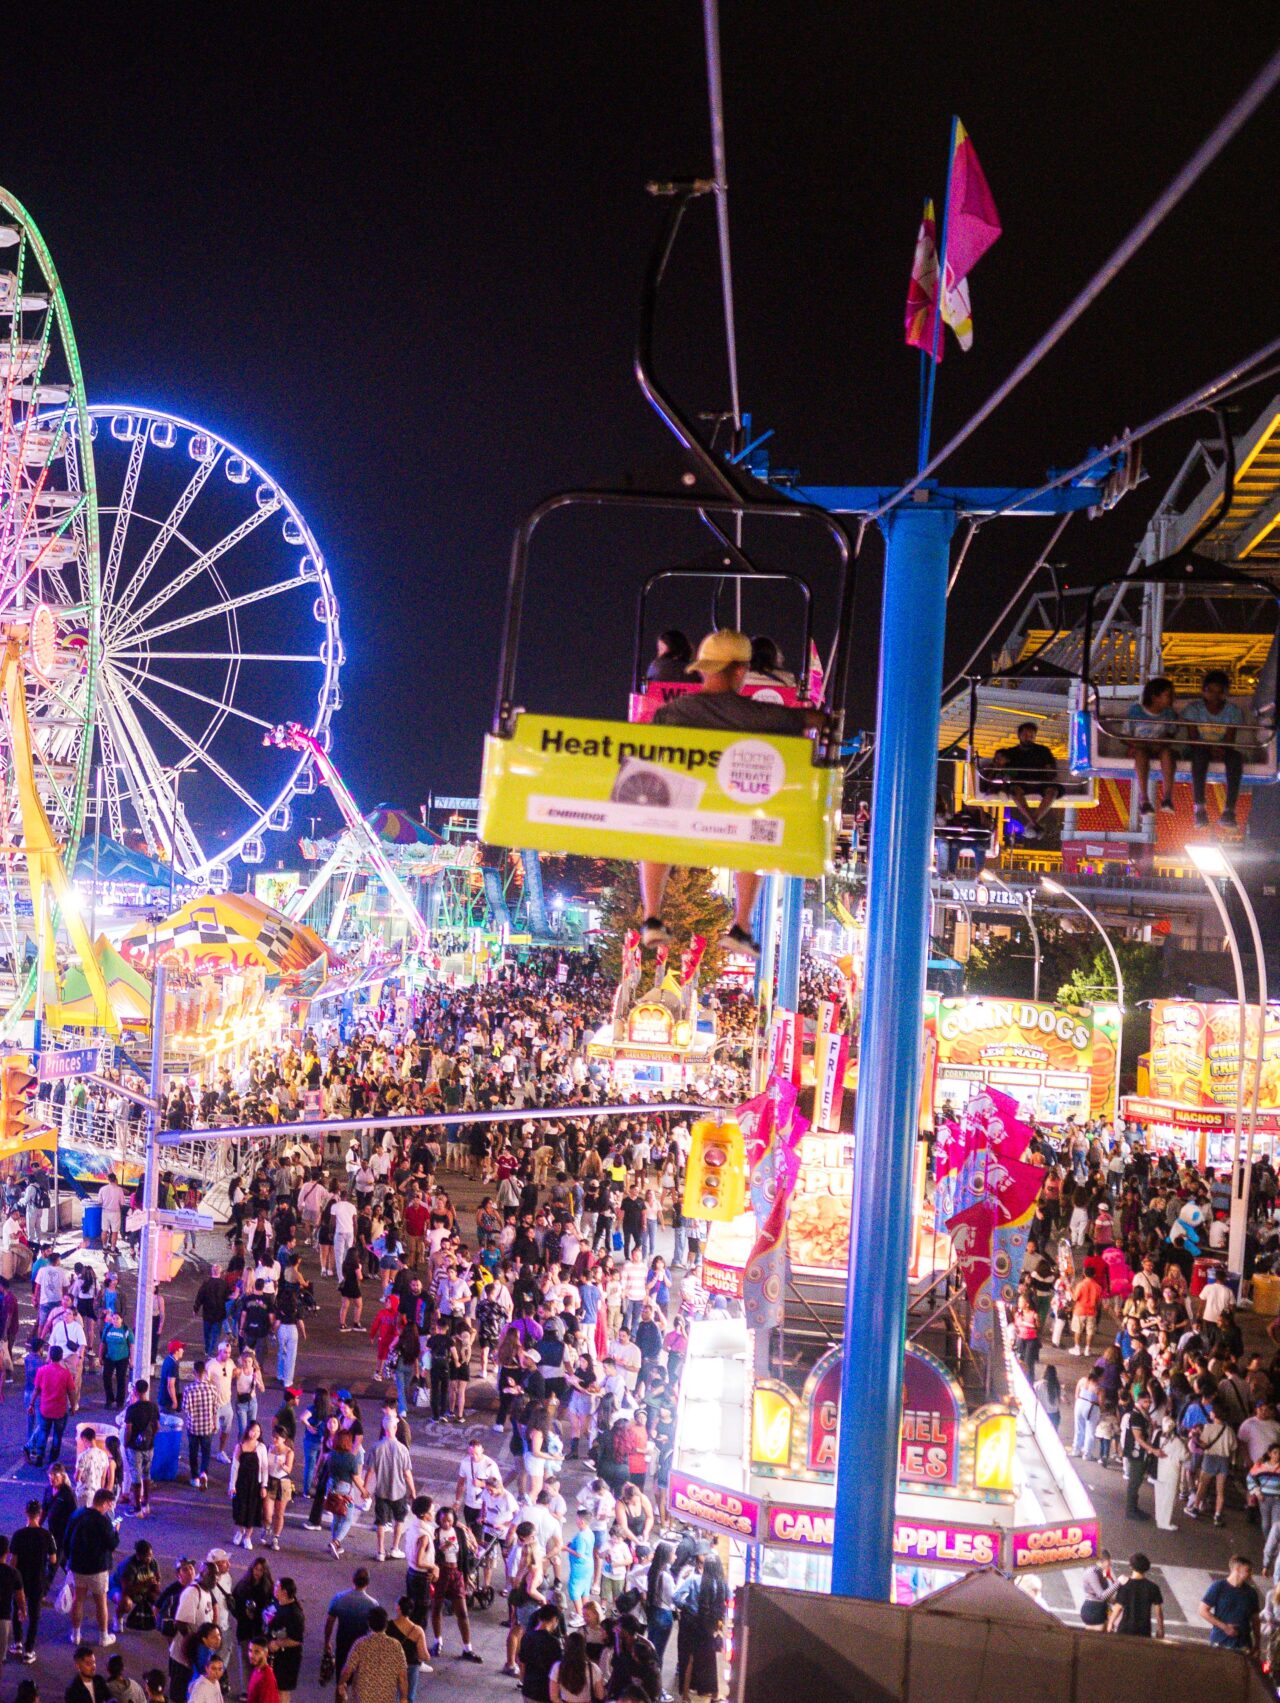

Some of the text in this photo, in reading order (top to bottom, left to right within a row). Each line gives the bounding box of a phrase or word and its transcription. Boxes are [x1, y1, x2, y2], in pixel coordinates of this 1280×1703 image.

[541, 728, 722, 770] Heat pumps
[728, 780, 770, 794] PLUS
[731, 771, 772, 781] REBATE
[989, 890, 1024, 904] FIELD
[941, 1004, 1090, 1050] CORN DOGS
[46, 1051, 85, 1075] Princes'
[821, 1041, 838, 1120] FRIES
[1175, 1111, 1222, 1124] NACHOS
[705, 1276, 738, 1293] SPUDS
[817, 1435, 948, 1479] AES
[675, 1492, 752, 1534] DRINKS
[686, 1484, 743, 1516] COLD
[774, 1513, 834, 1543] CAN
[1027, 1527, 1083, 1549] COLD
[1016, 1540, 1093, 1566] DRINKS
